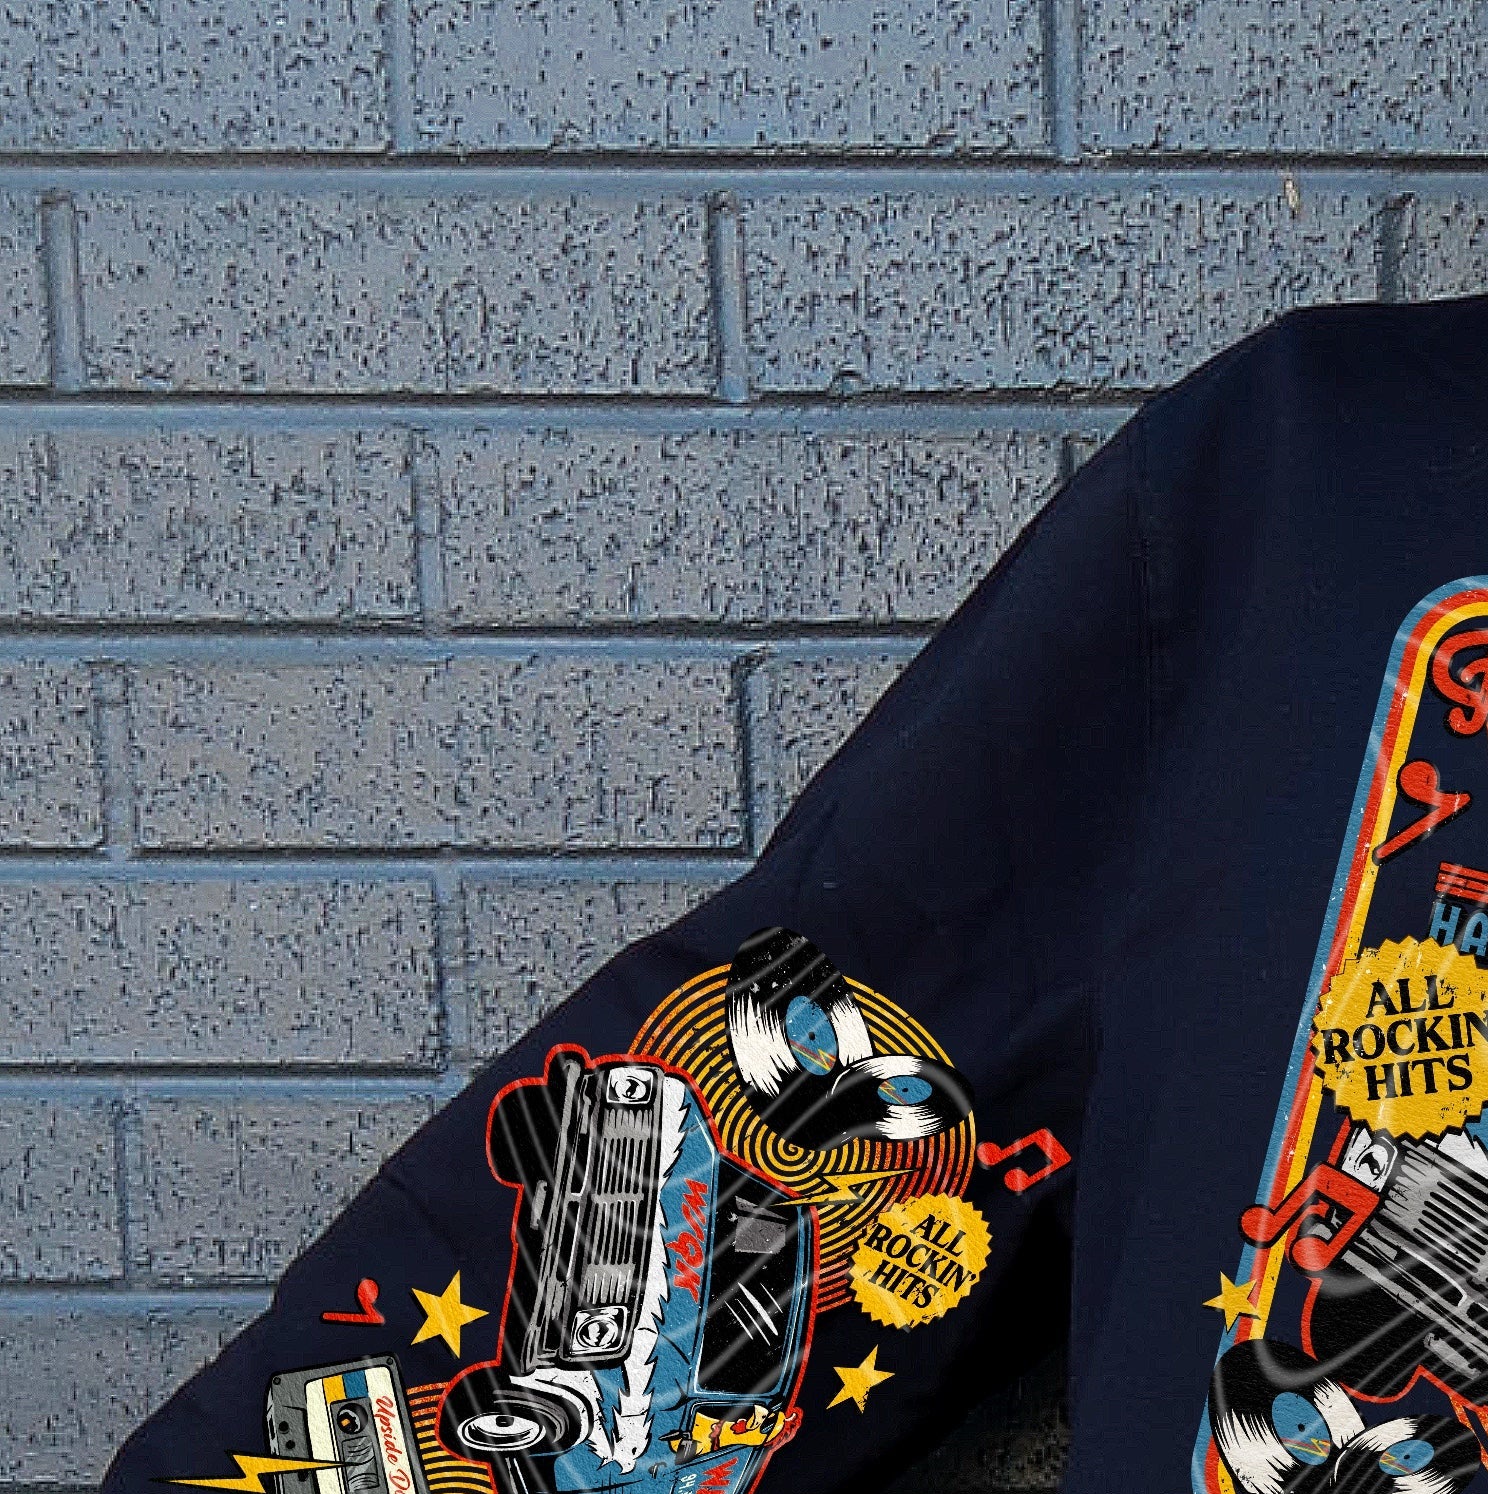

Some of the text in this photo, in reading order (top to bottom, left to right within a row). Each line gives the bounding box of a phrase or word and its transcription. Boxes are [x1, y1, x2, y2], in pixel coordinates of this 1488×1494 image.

[1365, 974, 1456, 1019] ALL
[1365, 1056, 1474, 1102] HITS
[665, 1178, 709, 1304] WSQK
[863, 1222, 977, 1293] ROCKIN'
[909, 1213, 967, 1258] ALL
[868, 1259, 941, 1309] HITS
[374, 1395, 403, 1466] Upside
